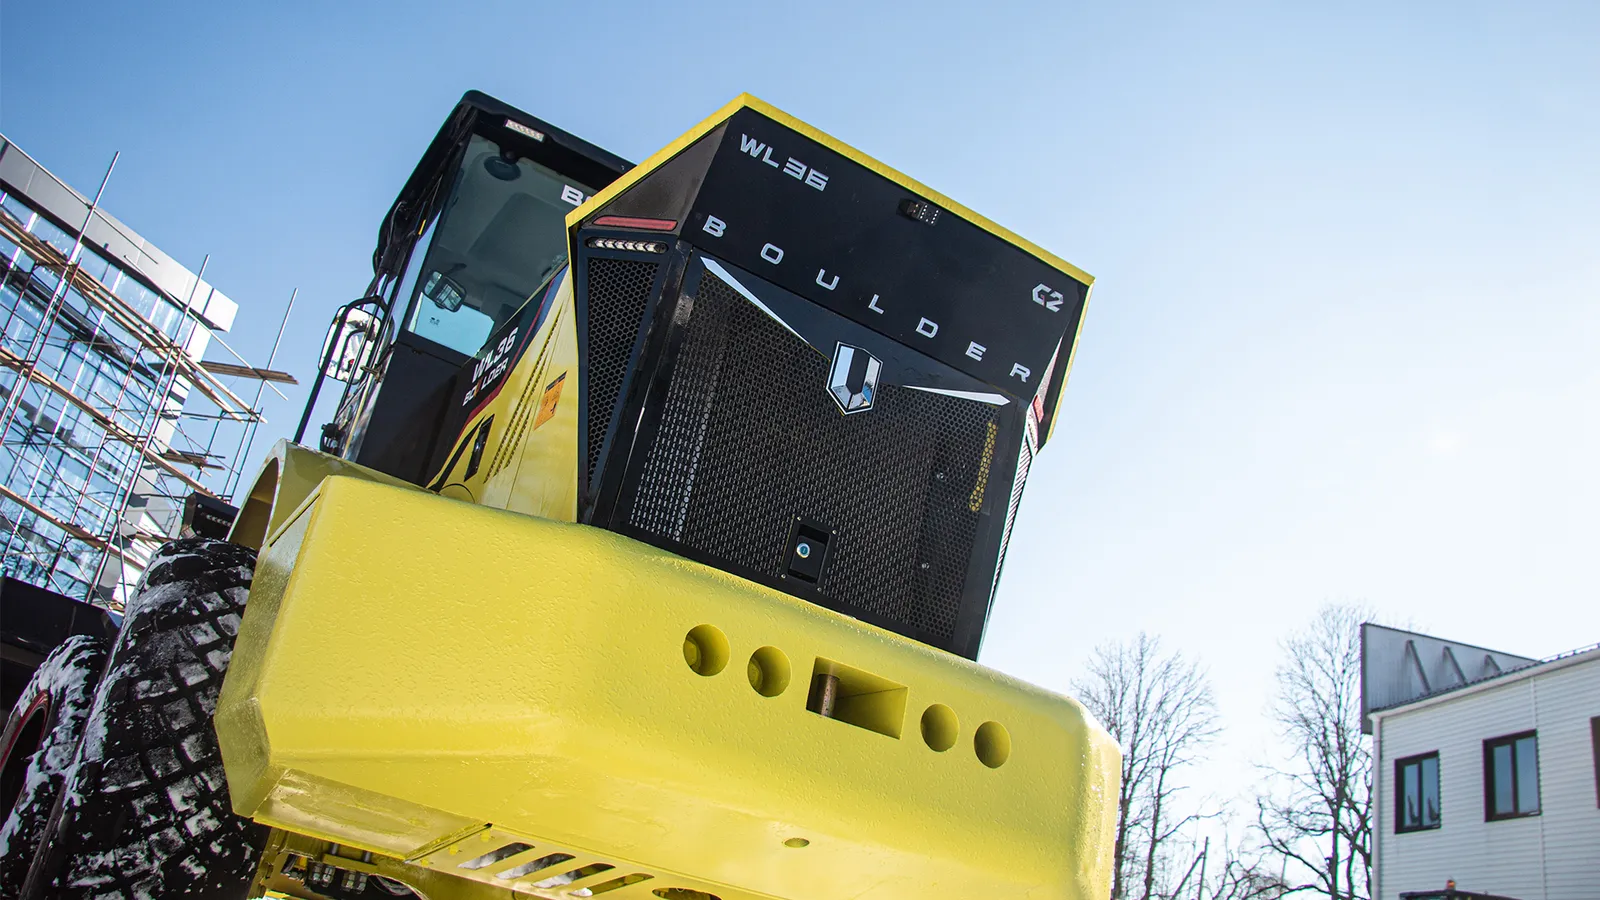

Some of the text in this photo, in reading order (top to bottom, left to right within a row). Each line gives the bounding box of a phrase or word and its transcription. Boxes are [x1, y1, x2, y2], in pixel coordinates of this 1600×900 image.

[740, 133, 830, 192] WL36
[560, 184, 593, 206] B
[703, 214, 1031, 383] BOULDER
[1032, 283, 1064, 313] G2
[472, 326, 519, 384] WL36
